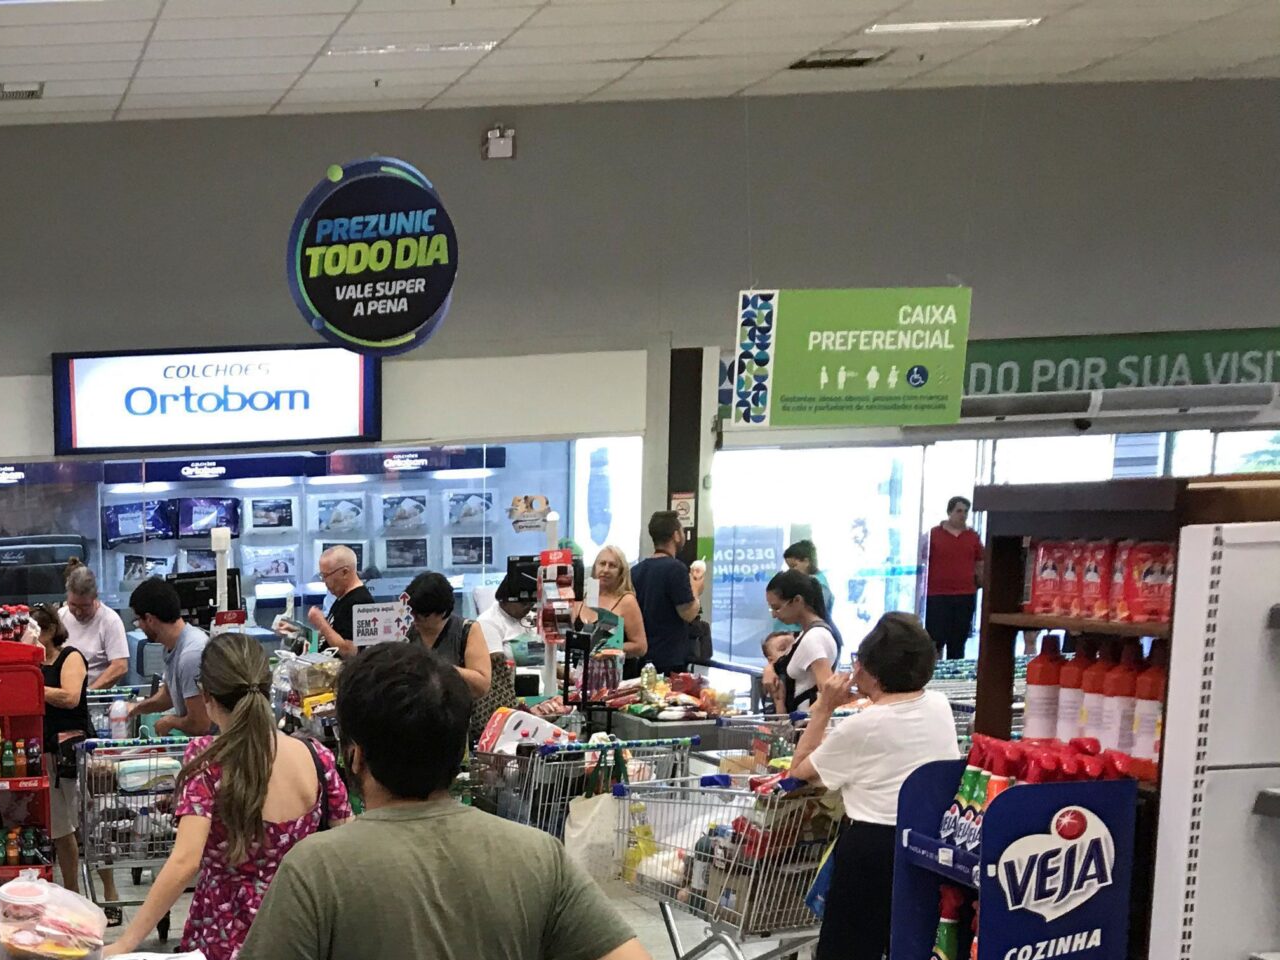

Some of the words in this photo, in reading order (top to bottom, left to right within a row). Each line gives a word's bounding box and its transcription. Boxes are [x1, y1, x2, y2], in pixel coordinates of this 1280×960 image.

[316, 208, 436, 243] PREZUNIC
[305, 240, 392, 278] TODO
[395, 234, 449, 269] DIA
[335, 283, 373, 300] VALE
[375, 278, 425, 296] SUPER
[353, 303, 364, 317] A
[368, 298, 408, 314] PENA
[899, 305, 957, 325] CAIXA
[808, 329, 954, 350] PREFERENCIAL
[970, 360, 1020, 395] DO
[1032, 356, 1107, 392] POR
[1117, 352, 1192, 388] SUA
[124, 384, 310, 416] Ortobom
[357, 620, 371, 629] SEM
[357, 628, 379, 637] PARAR
[1004, 837, 1110, 907] VEJA
